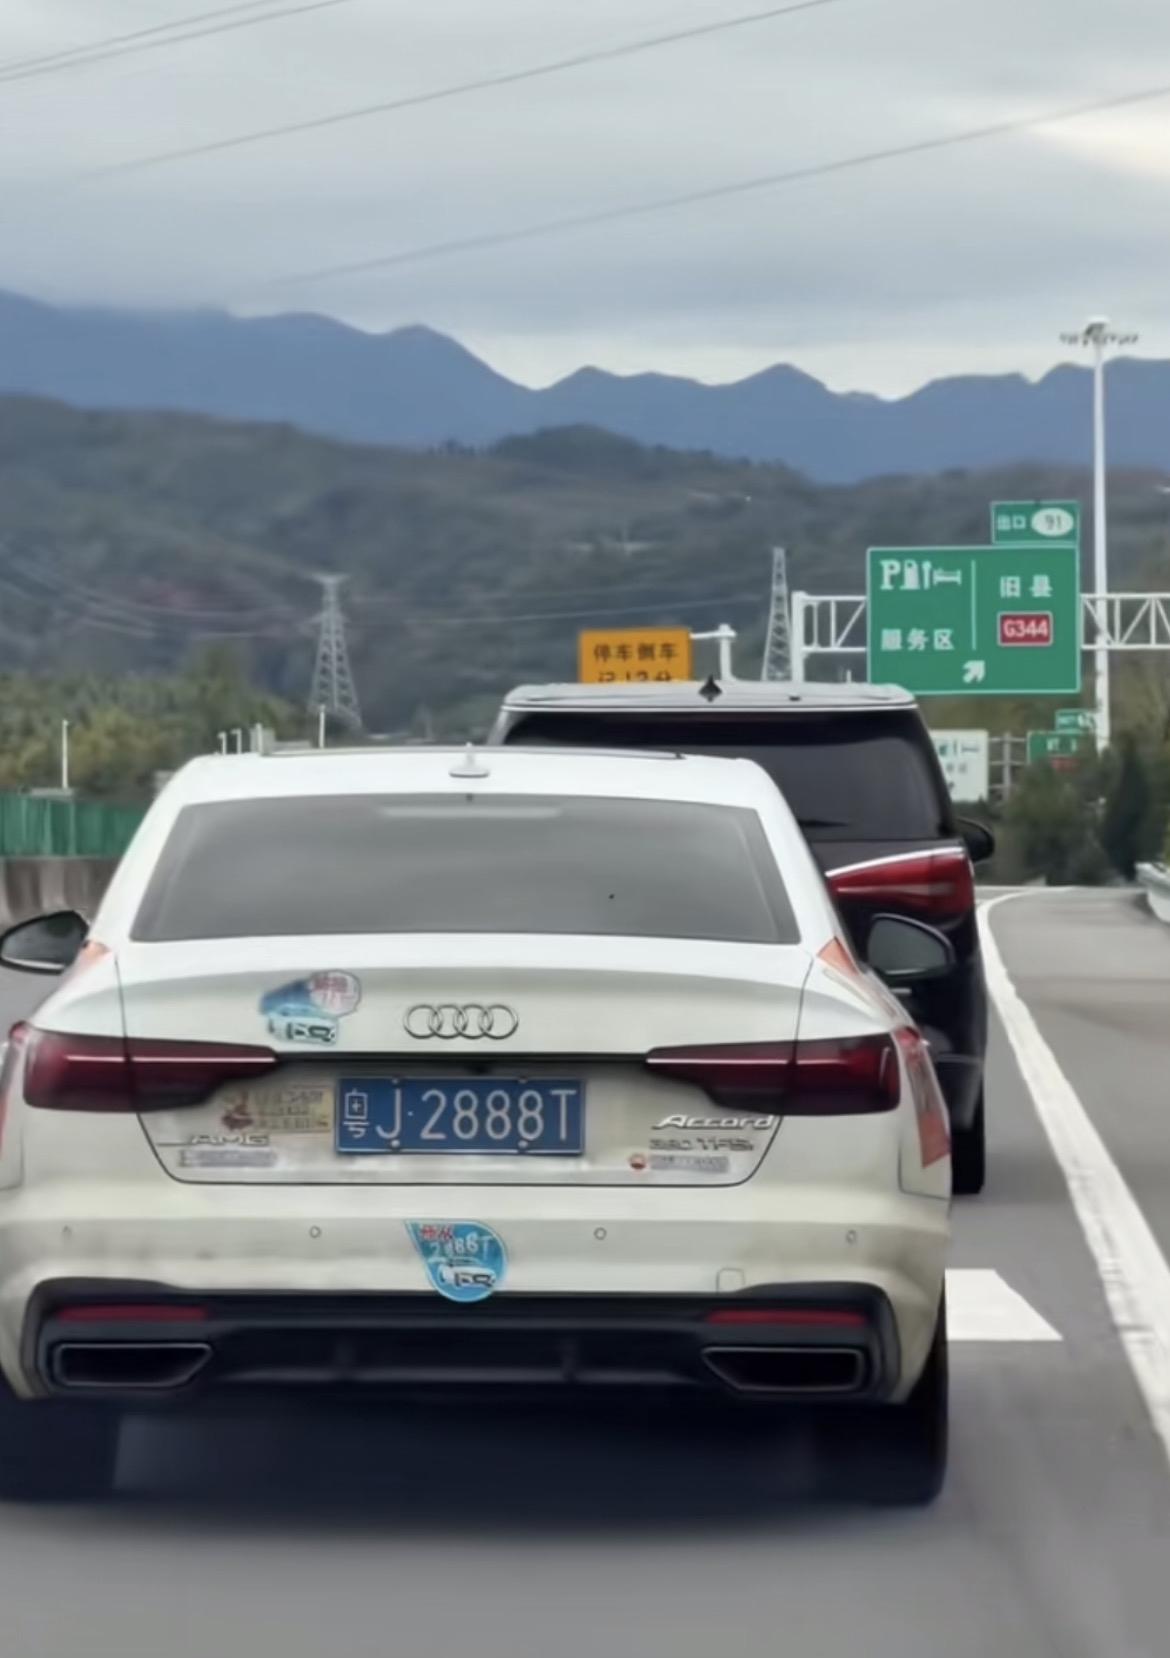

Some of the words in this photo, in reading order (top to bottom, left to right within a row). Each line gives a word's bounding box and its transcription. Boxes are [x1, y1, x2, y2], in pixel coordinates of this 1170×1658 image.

[999, 574, 1052, 598] 旧县
[1002, 619, 1049, 638] G344
[880, 628, 954, 651] 服务区
[652, 1114, 775, 1130] Accord
[190, 1134, 270, 1146] AMG
